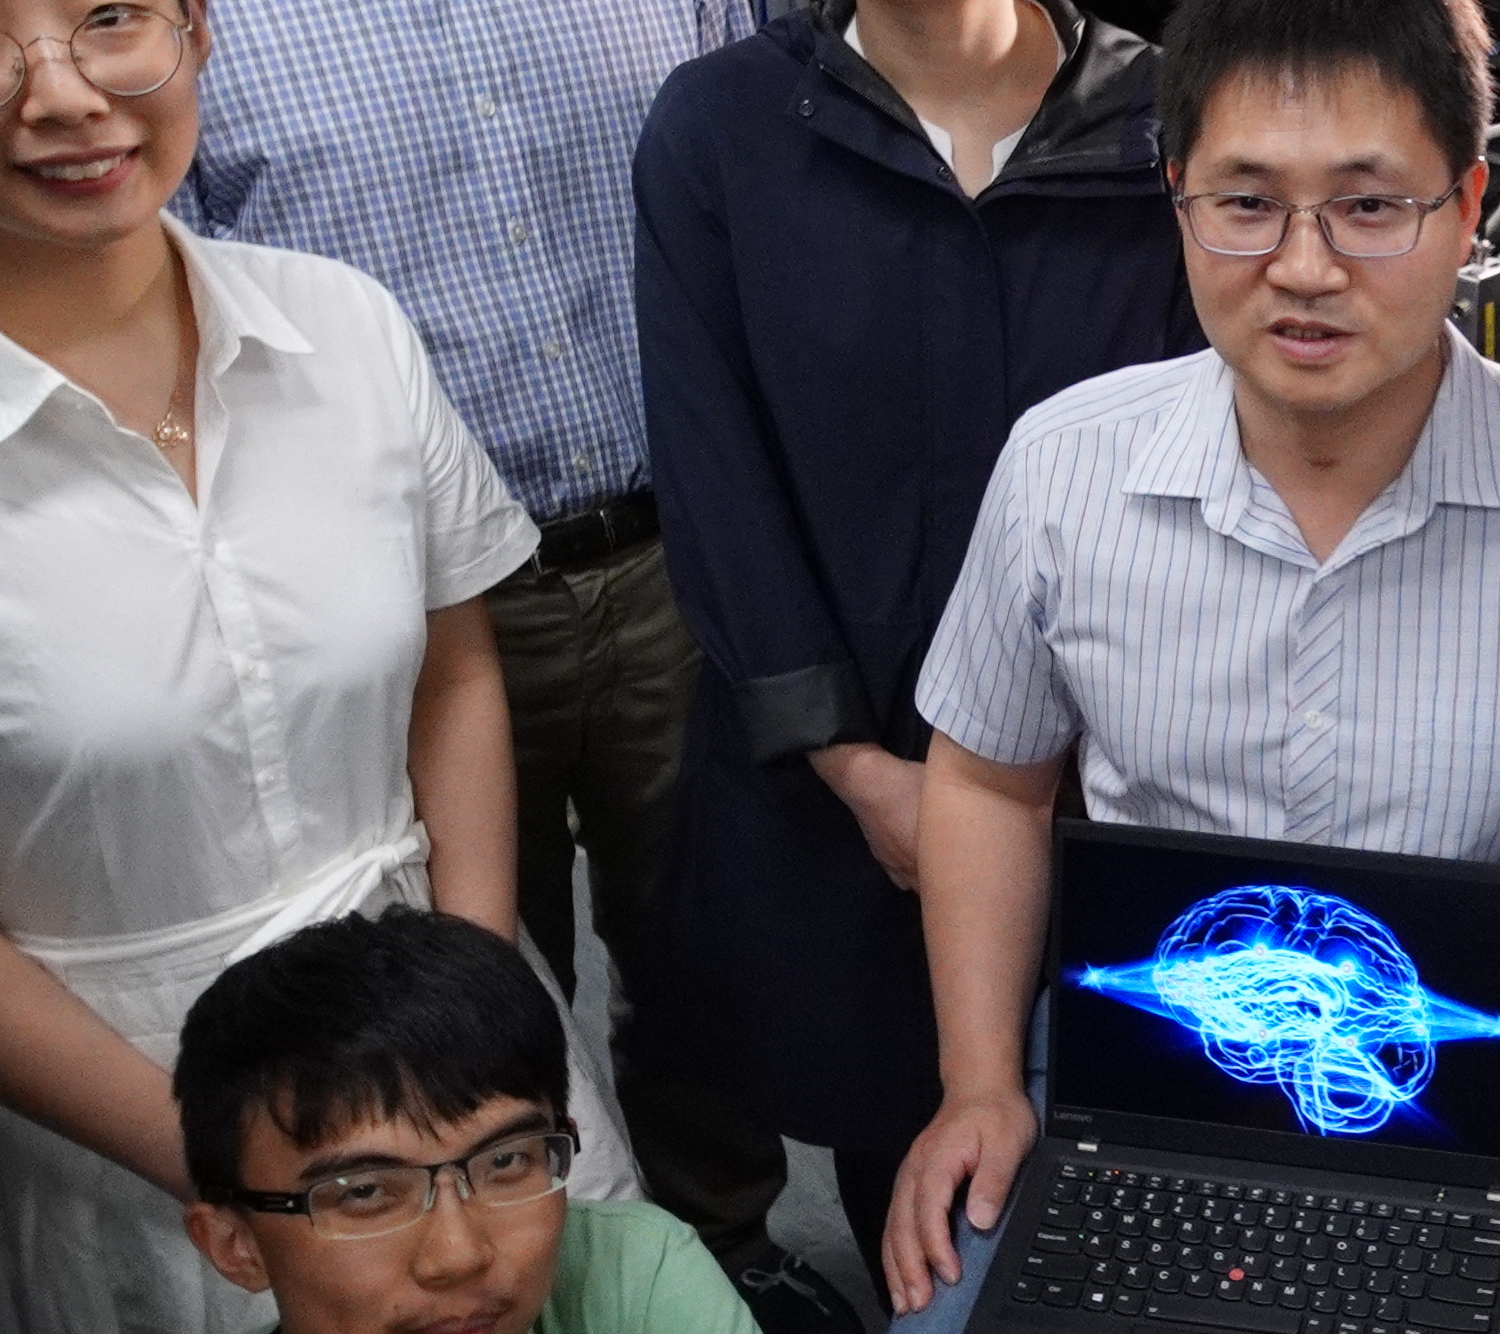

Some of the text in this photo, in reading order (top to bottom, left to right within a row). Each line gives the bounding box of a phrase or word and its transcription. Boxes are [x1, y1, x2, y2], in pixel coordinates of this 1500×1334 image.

[1092, 1211, 1377, 1253] Q W E R T Y U I O P
[1090, 1236, 1345, 1276] A S D F G H J K L
[1096, 1262, 1295, 1295] Z X C V B N M
